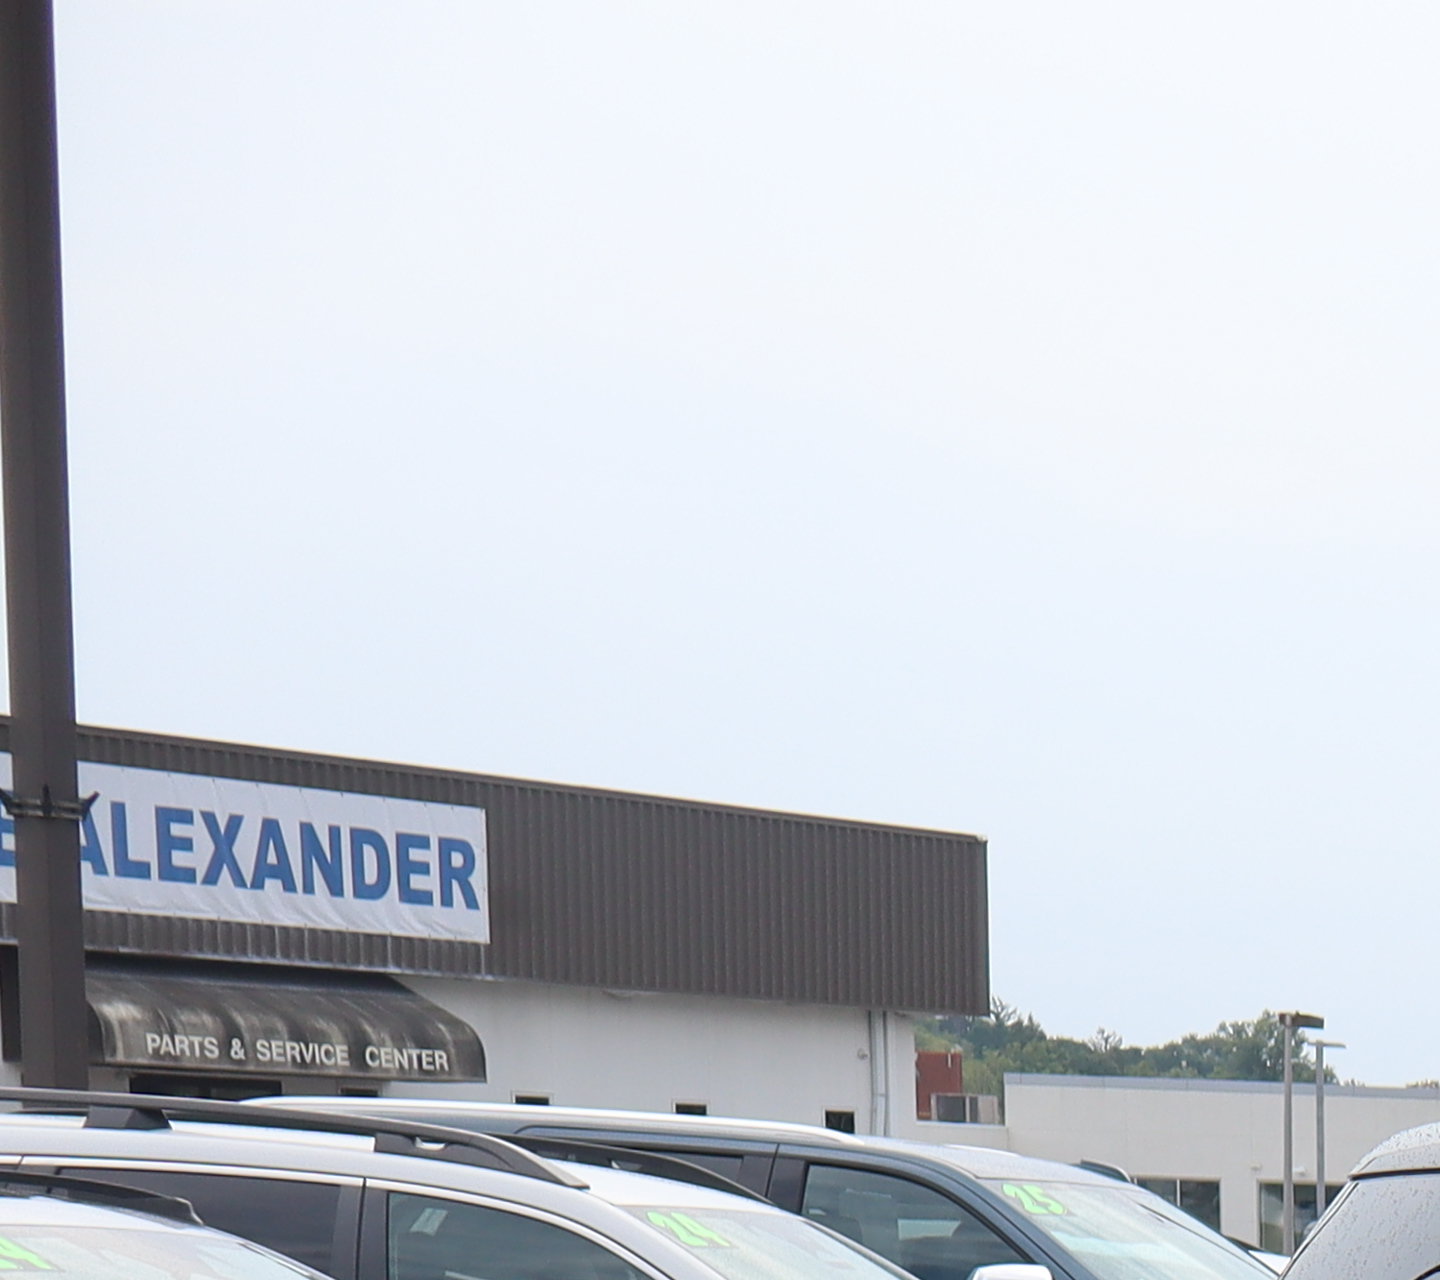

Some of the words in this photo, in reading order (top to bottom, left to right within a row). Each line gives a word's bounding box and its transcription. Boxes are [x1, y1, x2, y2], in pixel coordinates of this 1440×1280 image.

[145, 1033, 220, 1059] PARTS
[229, 1039, 246, 1061] &
[255, 1038, 350, 1067] SERVICE
[364, 1045, 450, 1072] CENTER
[1003, 1183, 1068, 1215] 25
[646, 1210, 731, 1247] 24
